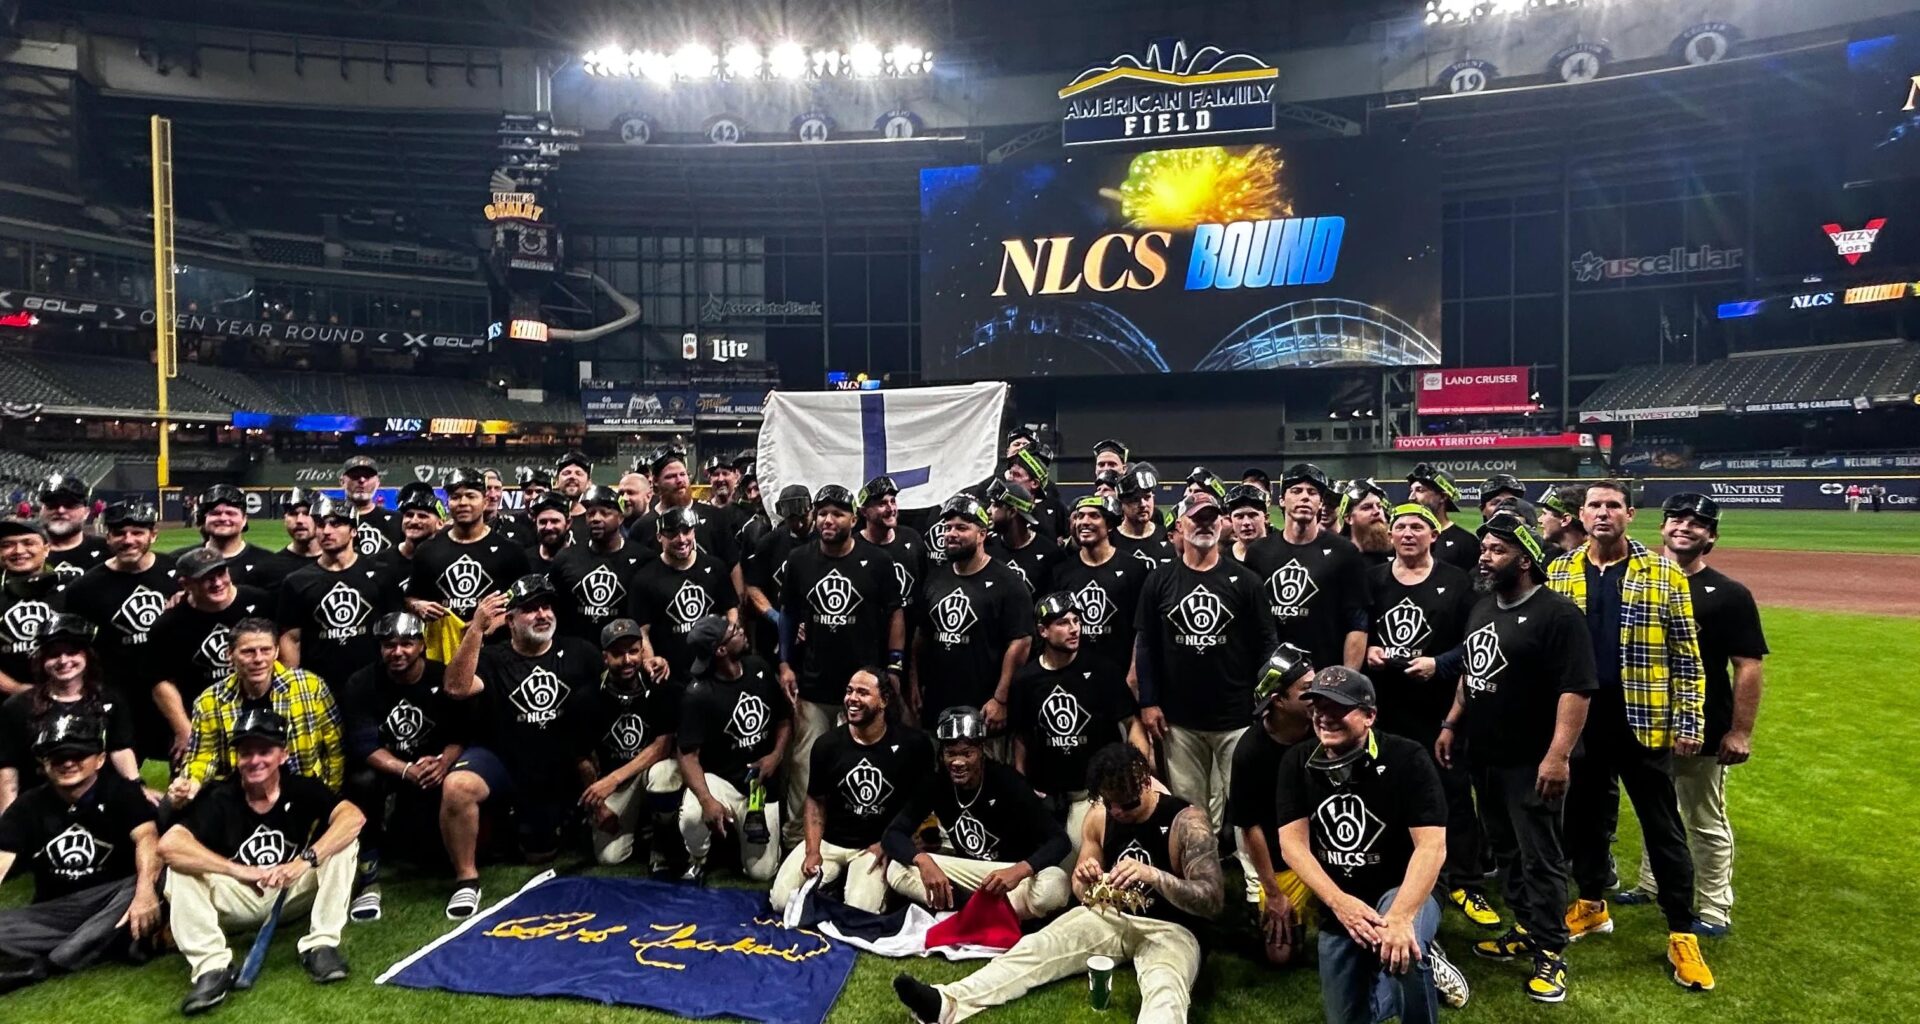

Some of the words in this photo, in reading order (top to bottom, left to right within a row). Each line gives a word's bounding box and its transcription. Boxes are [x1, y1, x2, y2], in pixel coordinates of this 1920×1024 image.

[1571, 57, 1586, 77] 4
[1456, 73, 1482, 93] 19
[1064, 92, 1182, 120] AMERICAN
[1189, 83, 1275, 110] FAMILY
[1124, 110, 1211, 136] FIELD
[624, 124, 647, 139] 34
[712, 125, 736, 139] 42
[802, 125, 825, 139] 44
[484, 202, 544, 221] CHALET
[1832, 229, 1876, 243] VIZZY
[1839, 243, 1869, 254] LOFT
[991, 231, 1172, 298] NLCS
[1184, 216, 1346, 291] BOUND
[1604, 245, 1743, 279] uscellular
[23, 297, 98, 314] GOLF
[1790, 292, 1835, 309] NLCS
[216, 318, 273, 337] YEAR
[285, 325, 365, 343] ROUND
[432, 336, 485, 349] GOLF
[711, 338, 749, 362] Lite
[1445, 376, 1474, 385] LAND
[1475, 375, 1518, 384] CRUISER
[734, 405, 762, 413] MILWAU
[1746, 404, 1770, 412] GREAT
[385, 418, 422, 432] NLCS
[860, 393, 931, 490] L
[1398, 438, 1437, 448] TOYOTA
[1438, 436, 1497, 446] TERRITORY
[1727, 459, 1760, 469] WELCOME
[296, 466, 335, 481] Tito's
[1888, 494, 1918, 504] Care
[930, 551, 948, 560] NLC
[449, 597, 477, 609] NLCS
[584, 605, 610, 617] NLCS
[1271, 605, 1299, 616] NLCS
[820, 614, 847, 625] NLCS
[327, 626, 358, 639] NLCS
[1081, 625, 1103, 635] NLCS
[939, 632, 961, 644] NLCS
[1185, 635, 1217, 646] NLCS
[13, 641, 40, 654] NLC
[527, 709, 557, 723] NLCS
[738, 733, 762, 748] NLCS
[1051, 735, 1079, 747] NLCS
[1328, 850, 1366, 867] NLCS
